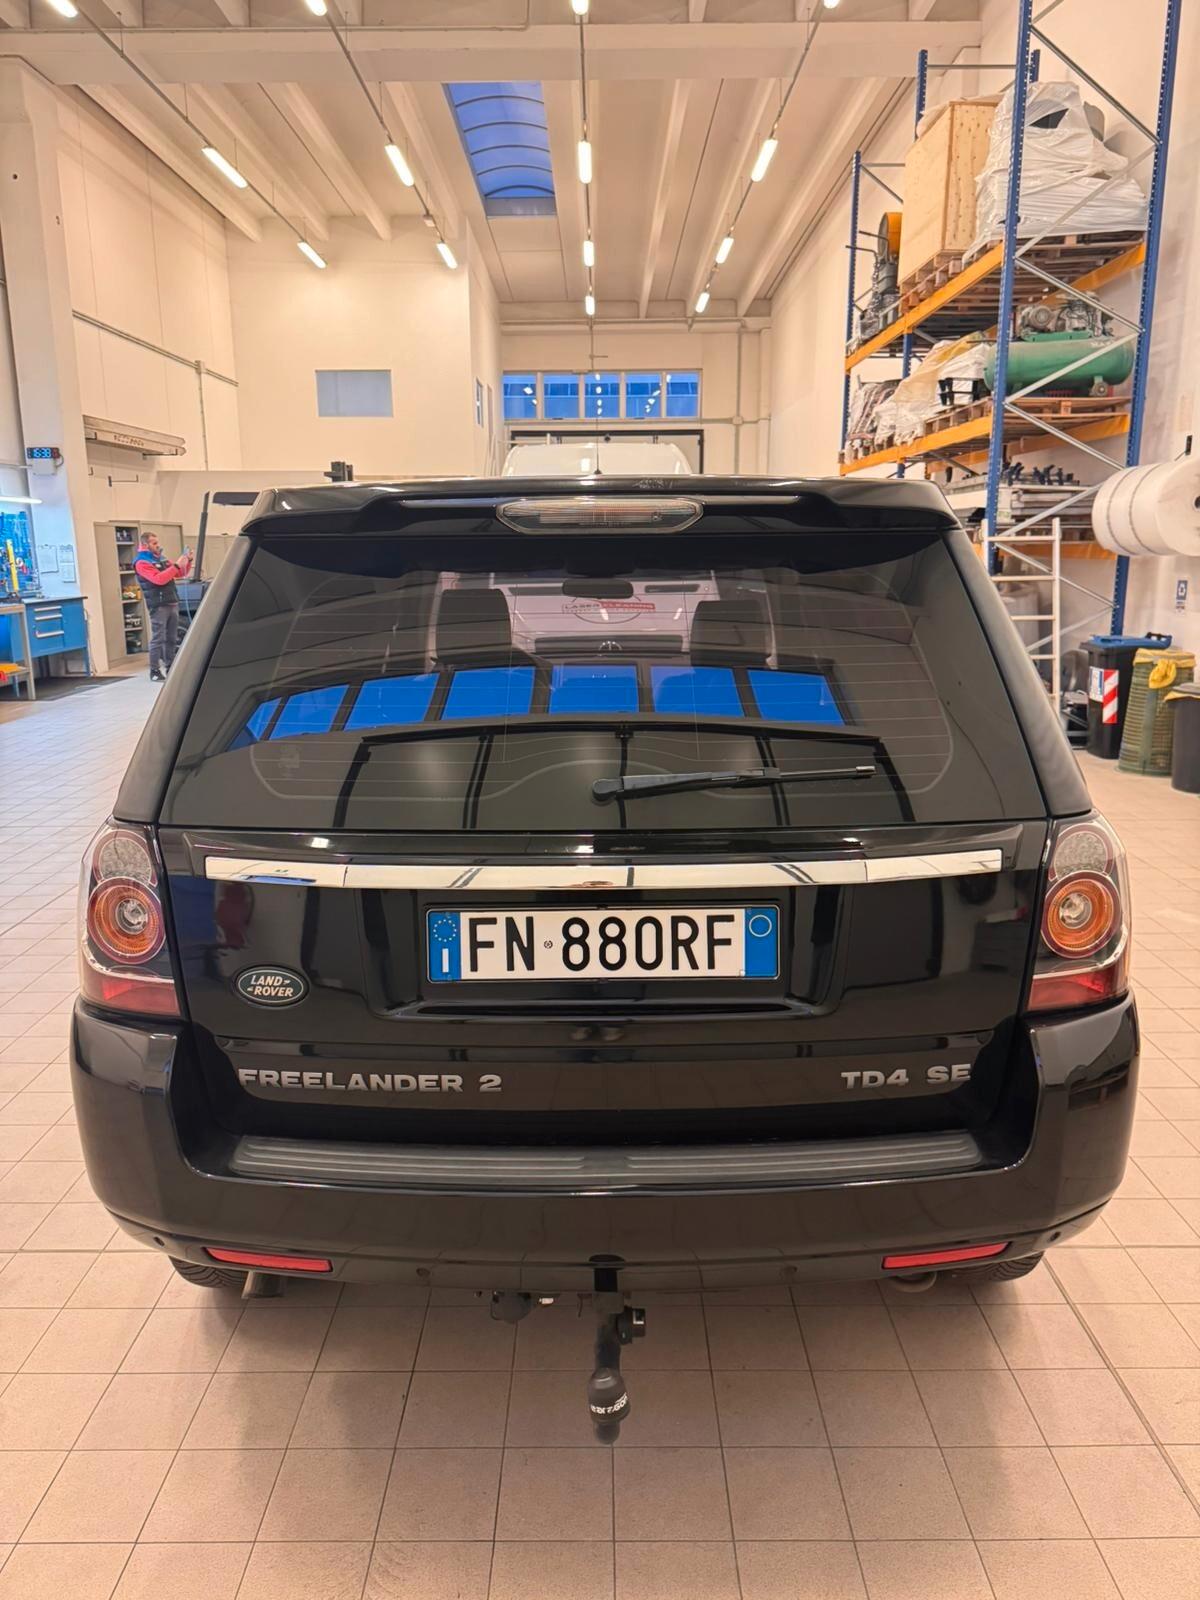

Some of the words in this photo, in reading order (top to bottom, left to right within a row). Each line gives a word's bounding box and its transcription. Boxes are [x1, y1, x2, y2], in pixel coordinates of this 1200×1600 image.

[469, 916, 535, 972] FN
[562, 915, 735, 972] 880RF
[250, 975, 283, 986] LAND
[254, 986, 294, 997] ROVER
[238, 1069, 463, 1093] FREELANDER
[479, 1074, 502, 1093] 2
[841, 1069, 909, 1089] TD4
[927, 1064, 971, 1084] SE
